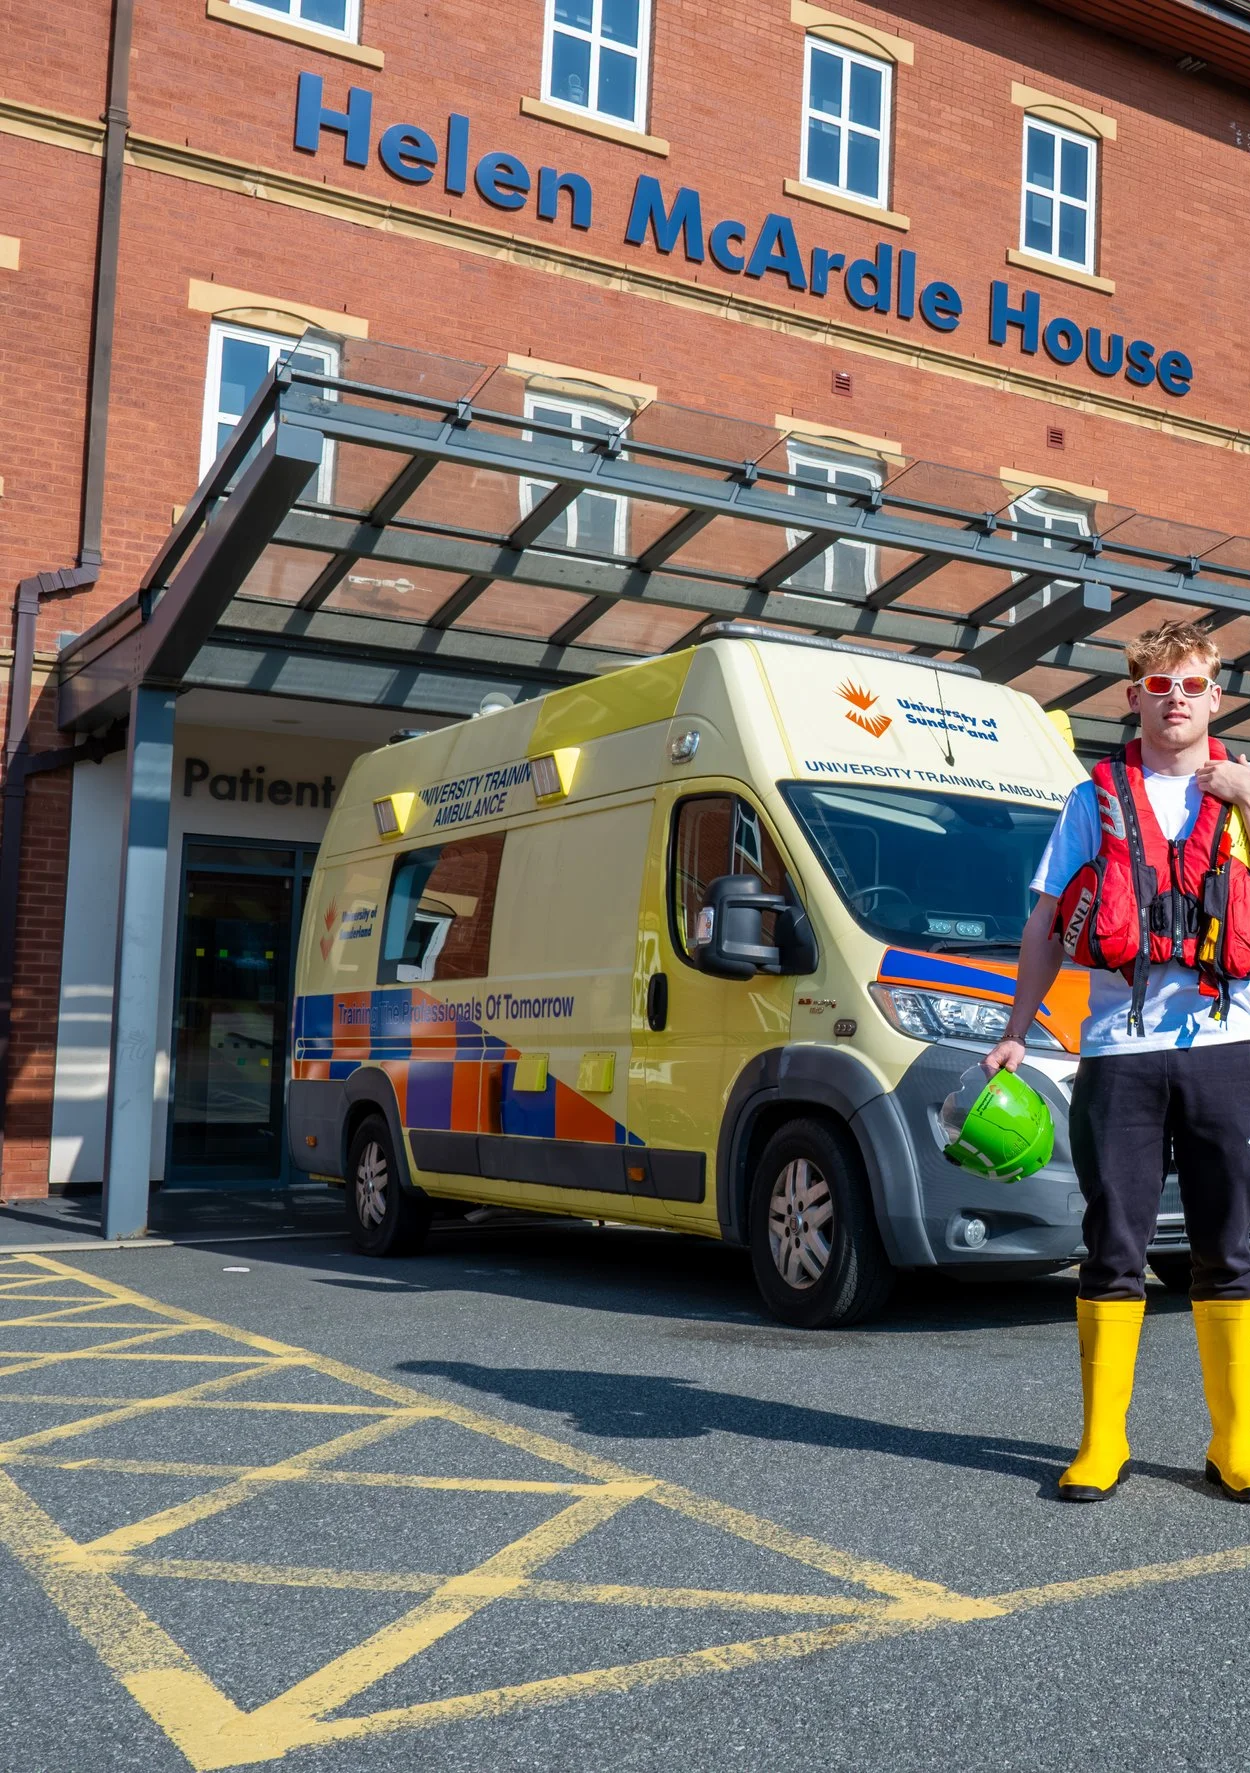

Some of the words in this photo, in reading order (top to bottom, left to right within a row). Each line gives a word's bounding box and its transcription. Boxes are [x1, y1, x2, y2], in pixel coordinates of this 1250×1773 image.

[294, 71, 592, 230] Helen
[625, 174, 963, 331] McArdle
[990, 280, 1193, 396] House
[982, 718, 998, 729] of
[184, 757, 336, 809] Patient
[484, 762, 531, 792] TRAININ
[806, 760, 911, 780] UNIVERSITY
[914, 770, 994, 791] TRAINING
[999, 783, 1068, 804] AMBULAN
[433, 792, 508, 827] AMBULANCE
[1065, 897, 1090, 946] RNLI
[338, 1003, 378, 1031] Training
[402, 997, 482, 1024] Professionals
[486, 995, 502, 1020] Of
[504, 994, 575, 1020] Tomorrow
